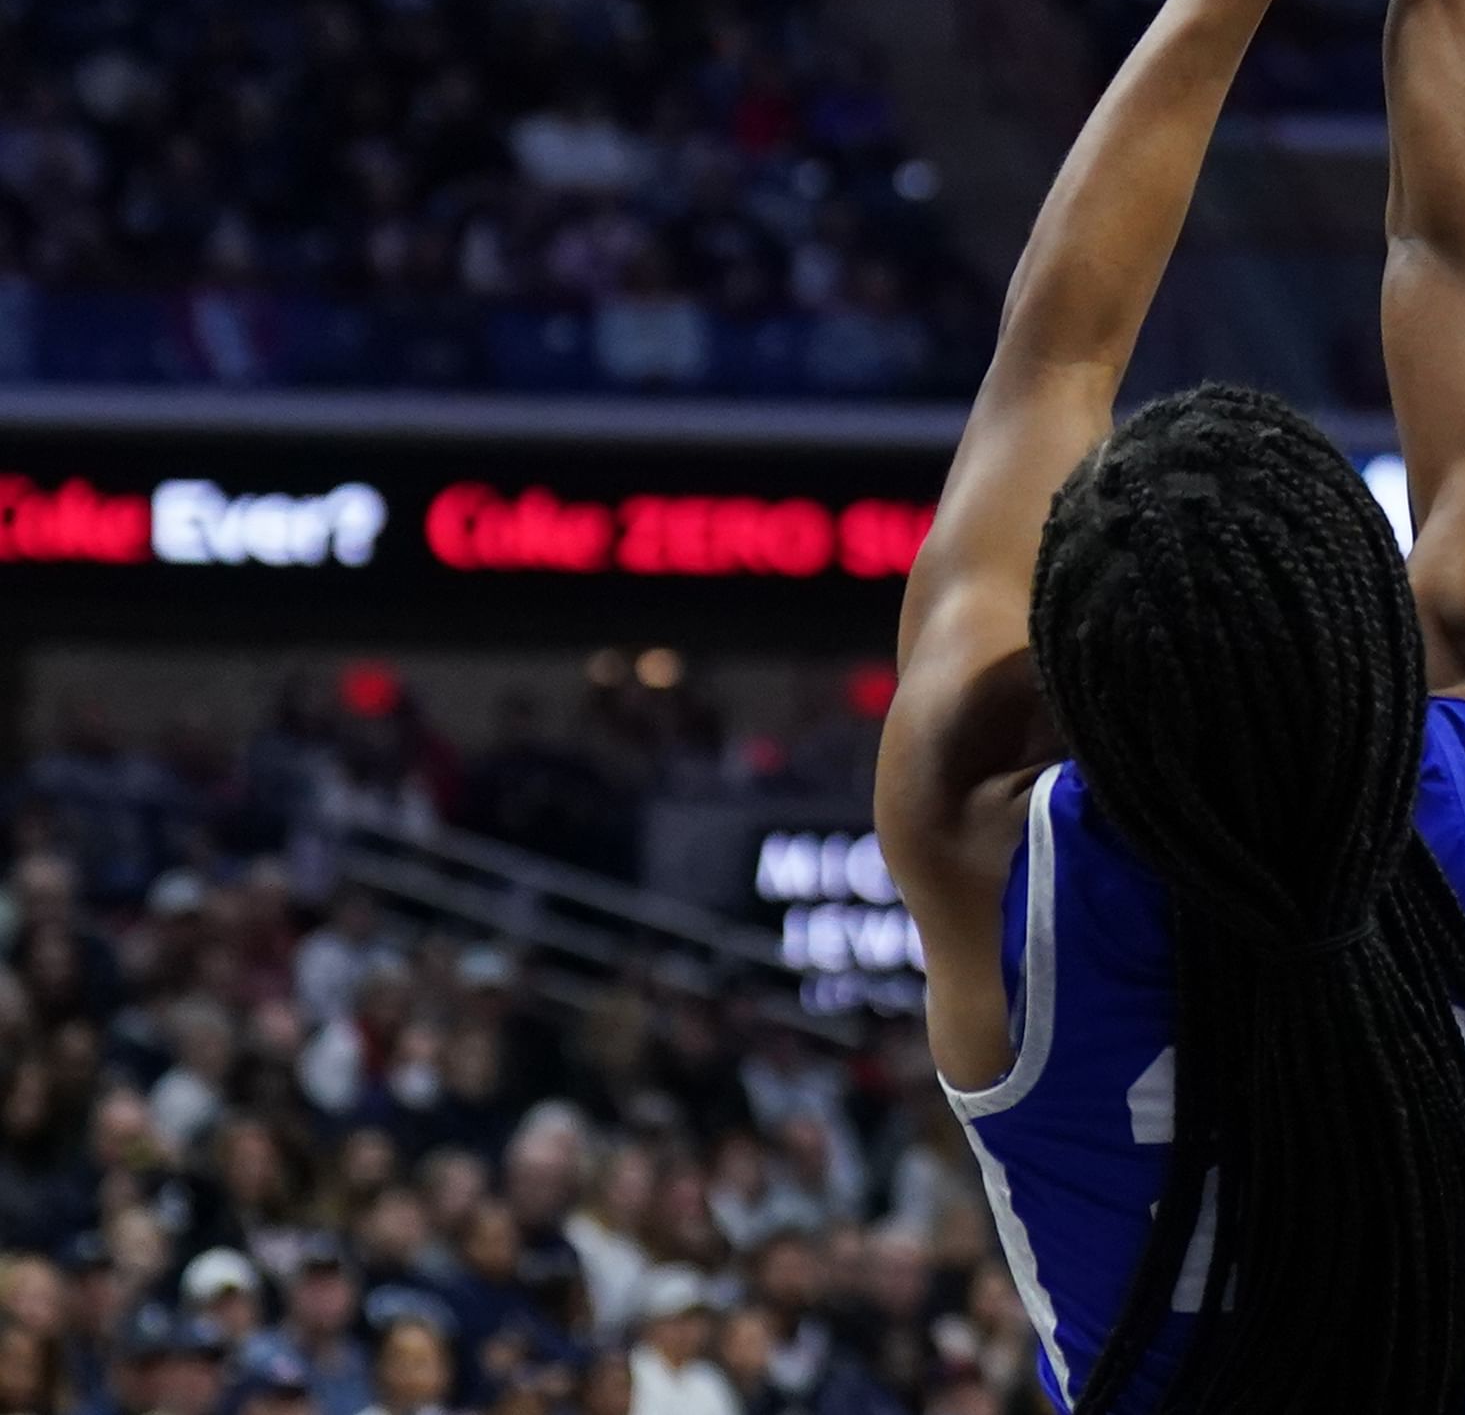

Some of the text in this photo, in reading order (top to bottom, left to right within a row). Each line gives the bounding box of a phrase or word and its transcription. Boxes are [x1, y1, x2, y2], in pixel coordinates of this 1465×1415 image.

[151, 478, 388, 567] Ever?
[426, 479, 614, 571] Coke
[616, 494, 833, 579] ZERO
